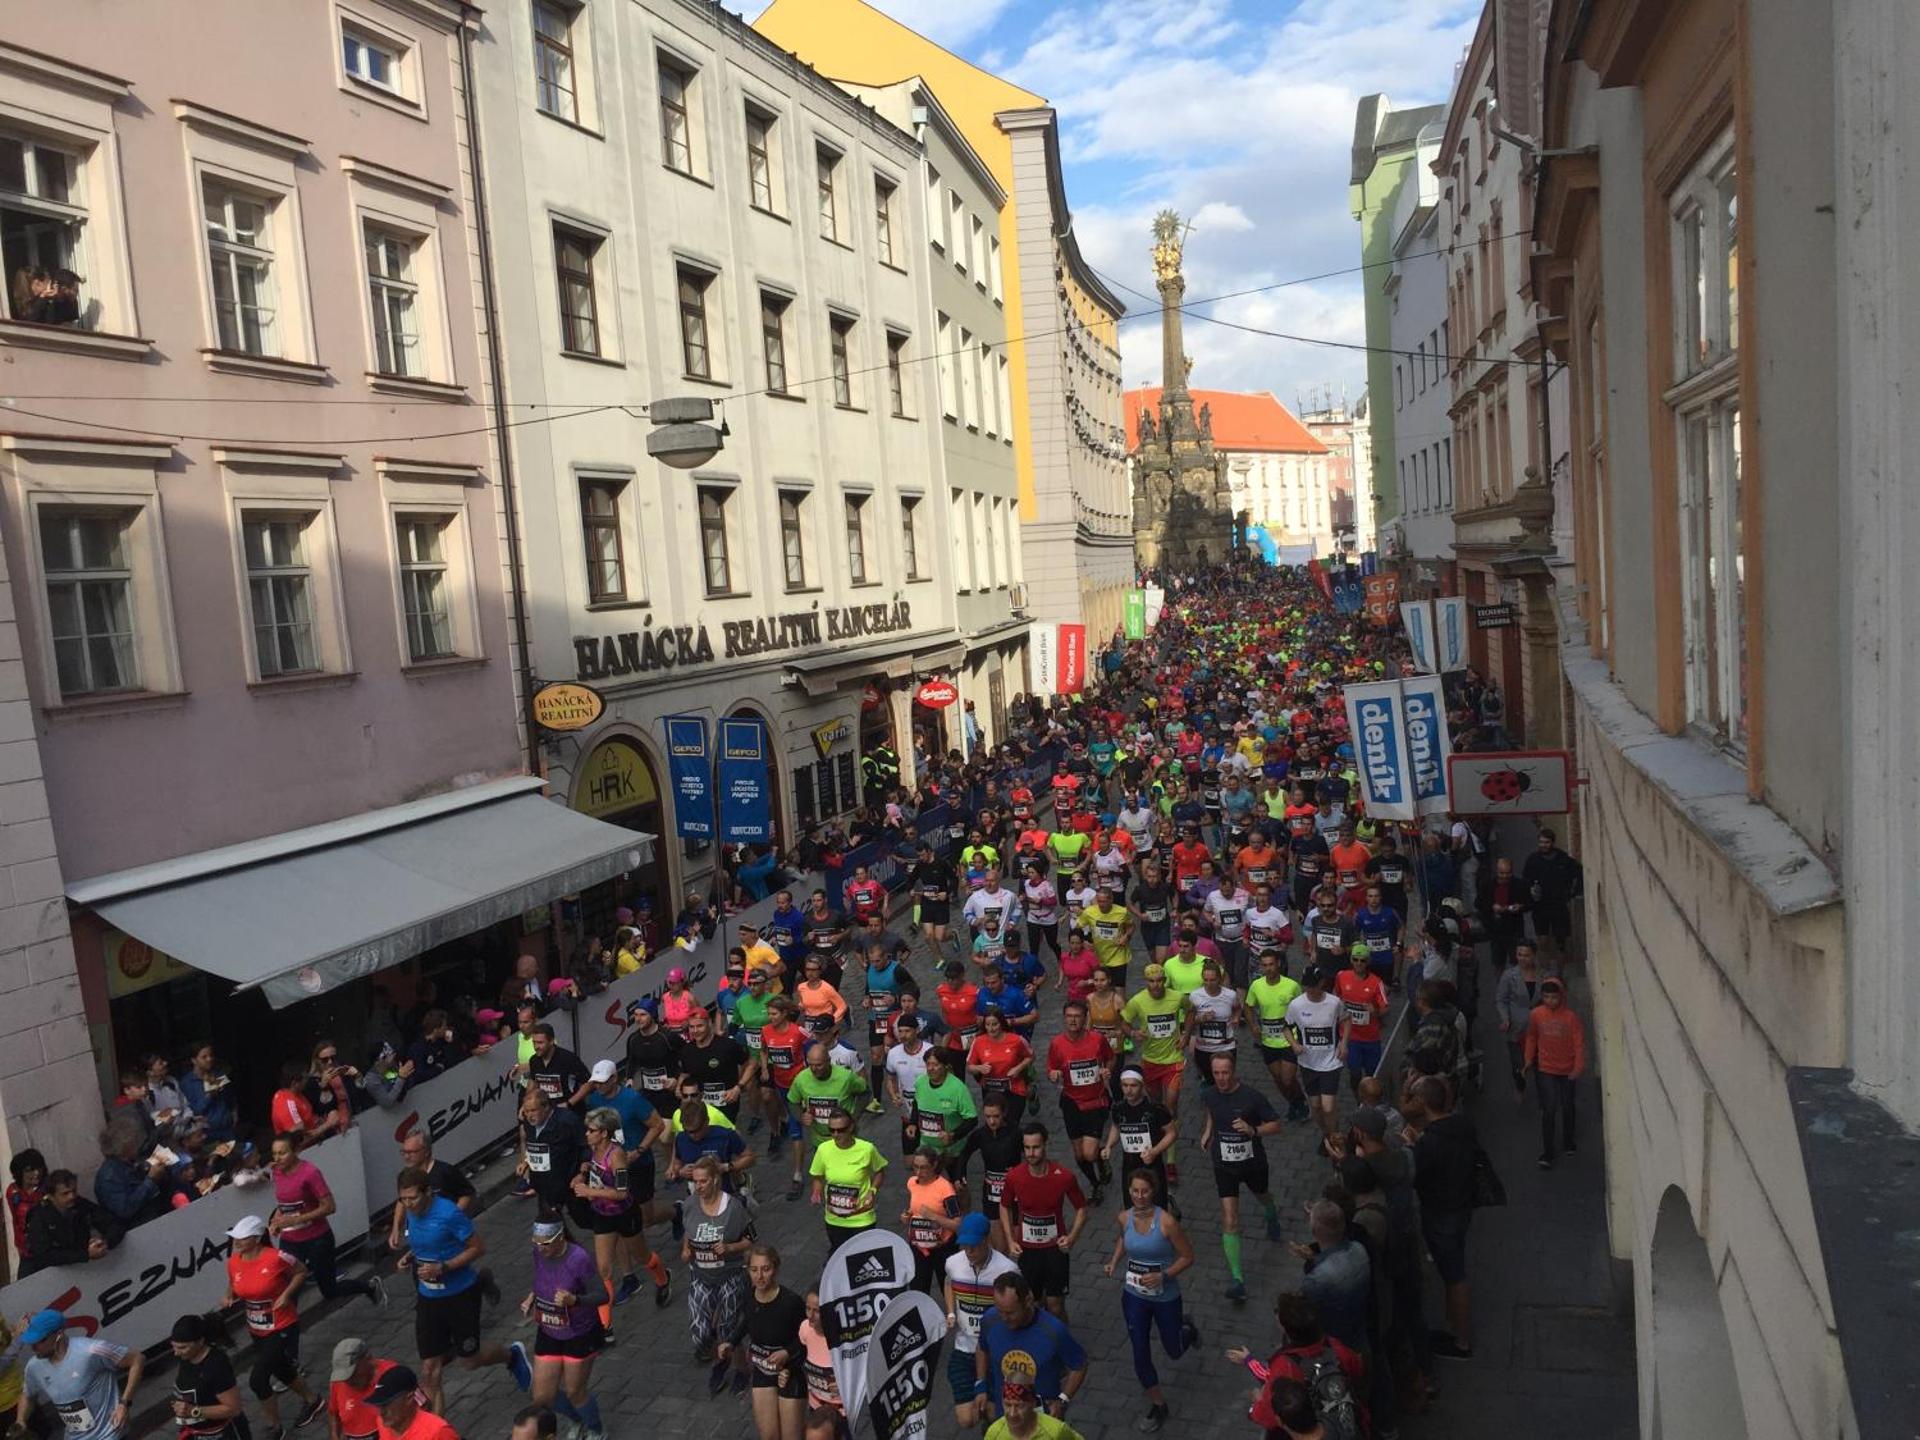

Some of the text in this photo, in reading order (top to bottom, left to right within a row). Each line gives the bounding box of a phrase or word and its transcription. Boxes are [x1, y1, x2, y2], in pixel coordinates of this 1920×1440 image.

[722, 600, 822, 659] REALITNÍ
[538, 692, 593, 709] HANÁCKÁ
[589, 768, 636, 806] HRK
[855, 1269, 890, 1283] adidas
[834, 1292, 891, 1329] 1:50
[890, 1332, 921, 1361] adidas
[879, 1359, 929, 1419] 1:50
